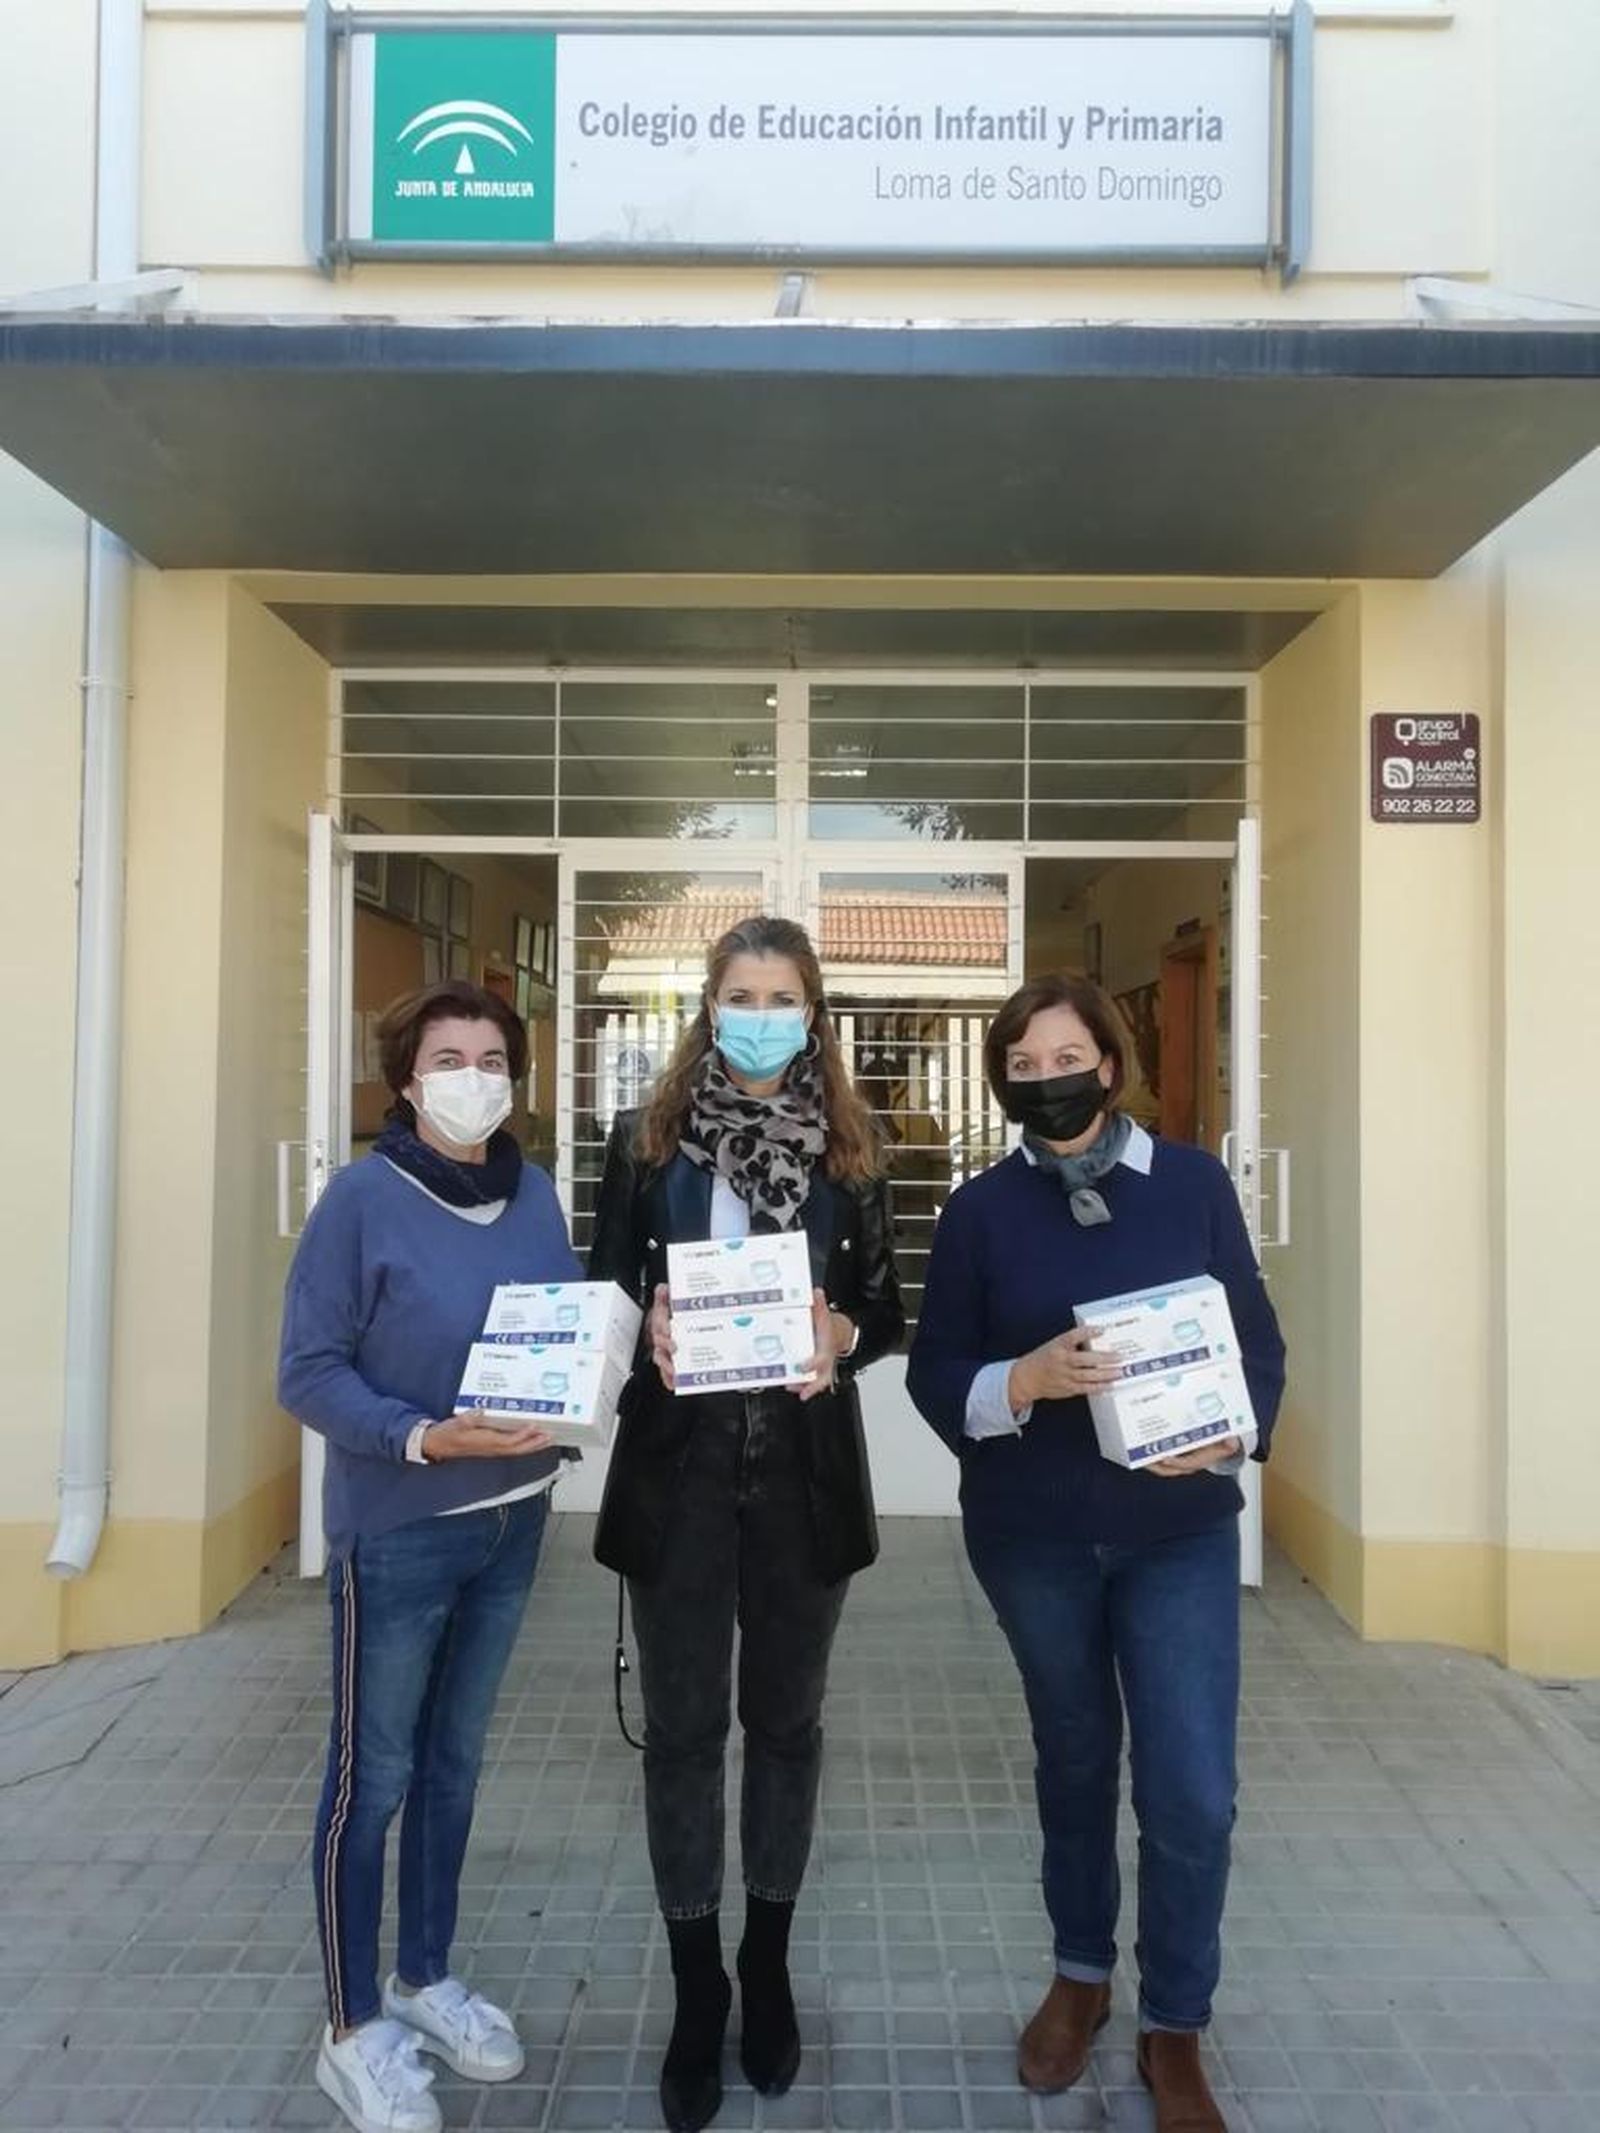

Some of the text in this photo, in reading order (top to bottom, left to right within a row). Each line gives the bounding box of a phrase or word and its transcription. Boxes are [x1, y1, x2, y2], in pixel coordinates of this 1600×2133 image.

[579, 101, 1223, 149] Colegio de Educación Infantil y Primaria
[394, 180, 437, 197] JUNTA
[442, 180, 458, 197] DE
[875, 165, 1223, 208] Loma de Santo Domingo
[1416, 760, 1476, 772] ALARMA
[1382, 798, 1477, 814] 902 26 22 22
